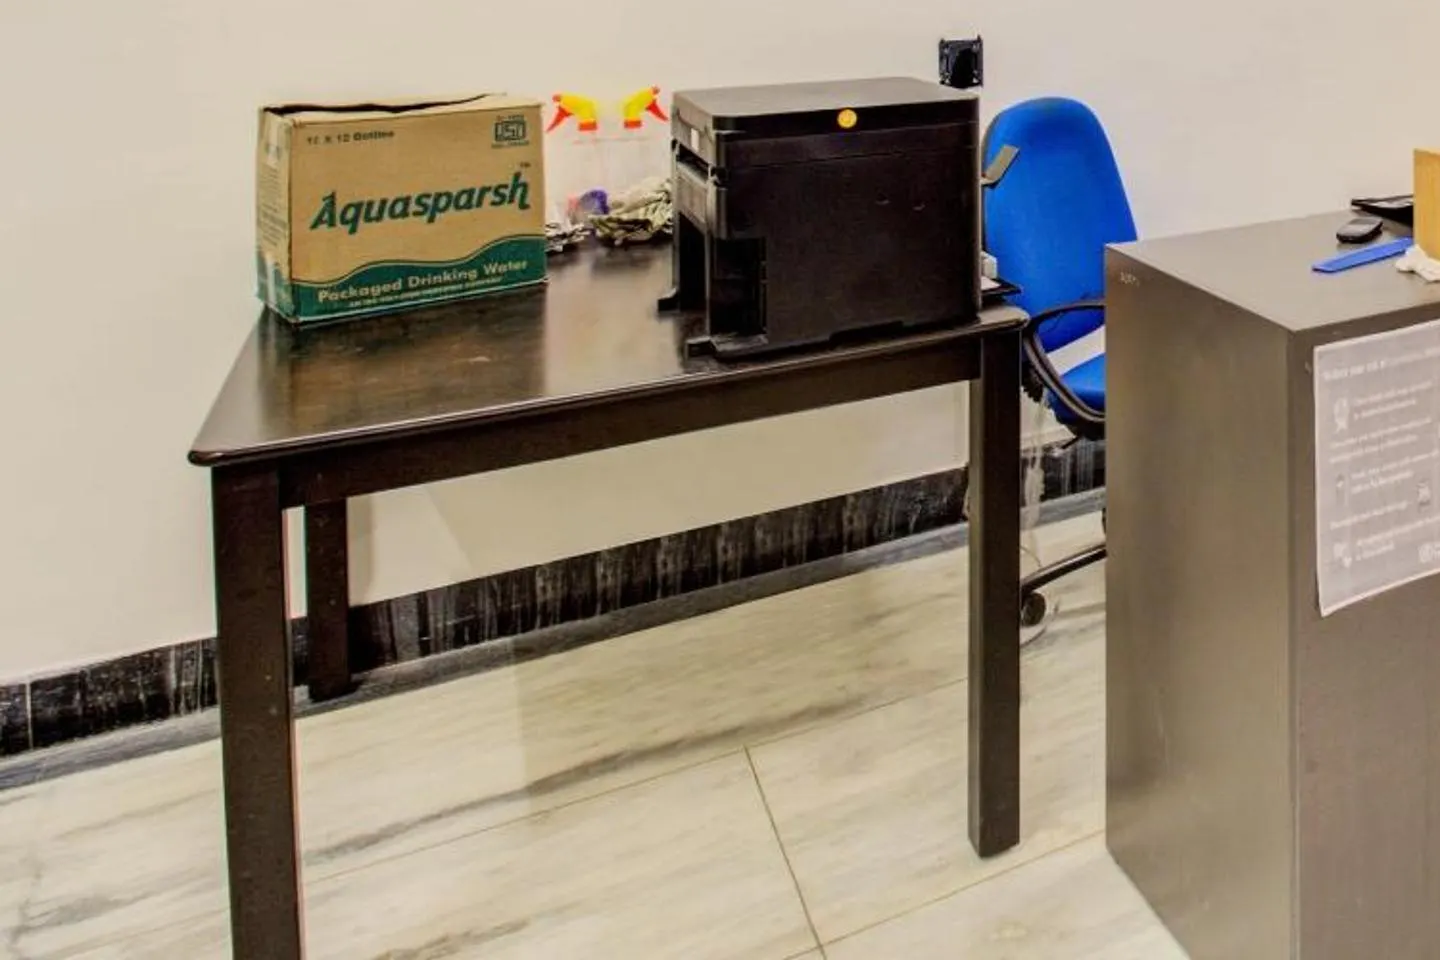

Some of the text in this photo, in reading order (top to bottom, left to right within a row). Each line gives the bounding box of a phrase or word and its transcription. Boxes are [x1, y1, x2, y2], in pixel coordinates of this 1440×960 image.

[309, 171, 531, 235] Aquasparsh
[318, 276, 403, 303] Packaged
[407, 266, 479, 289] Drinking
[483, 259, 529, 276] Water
